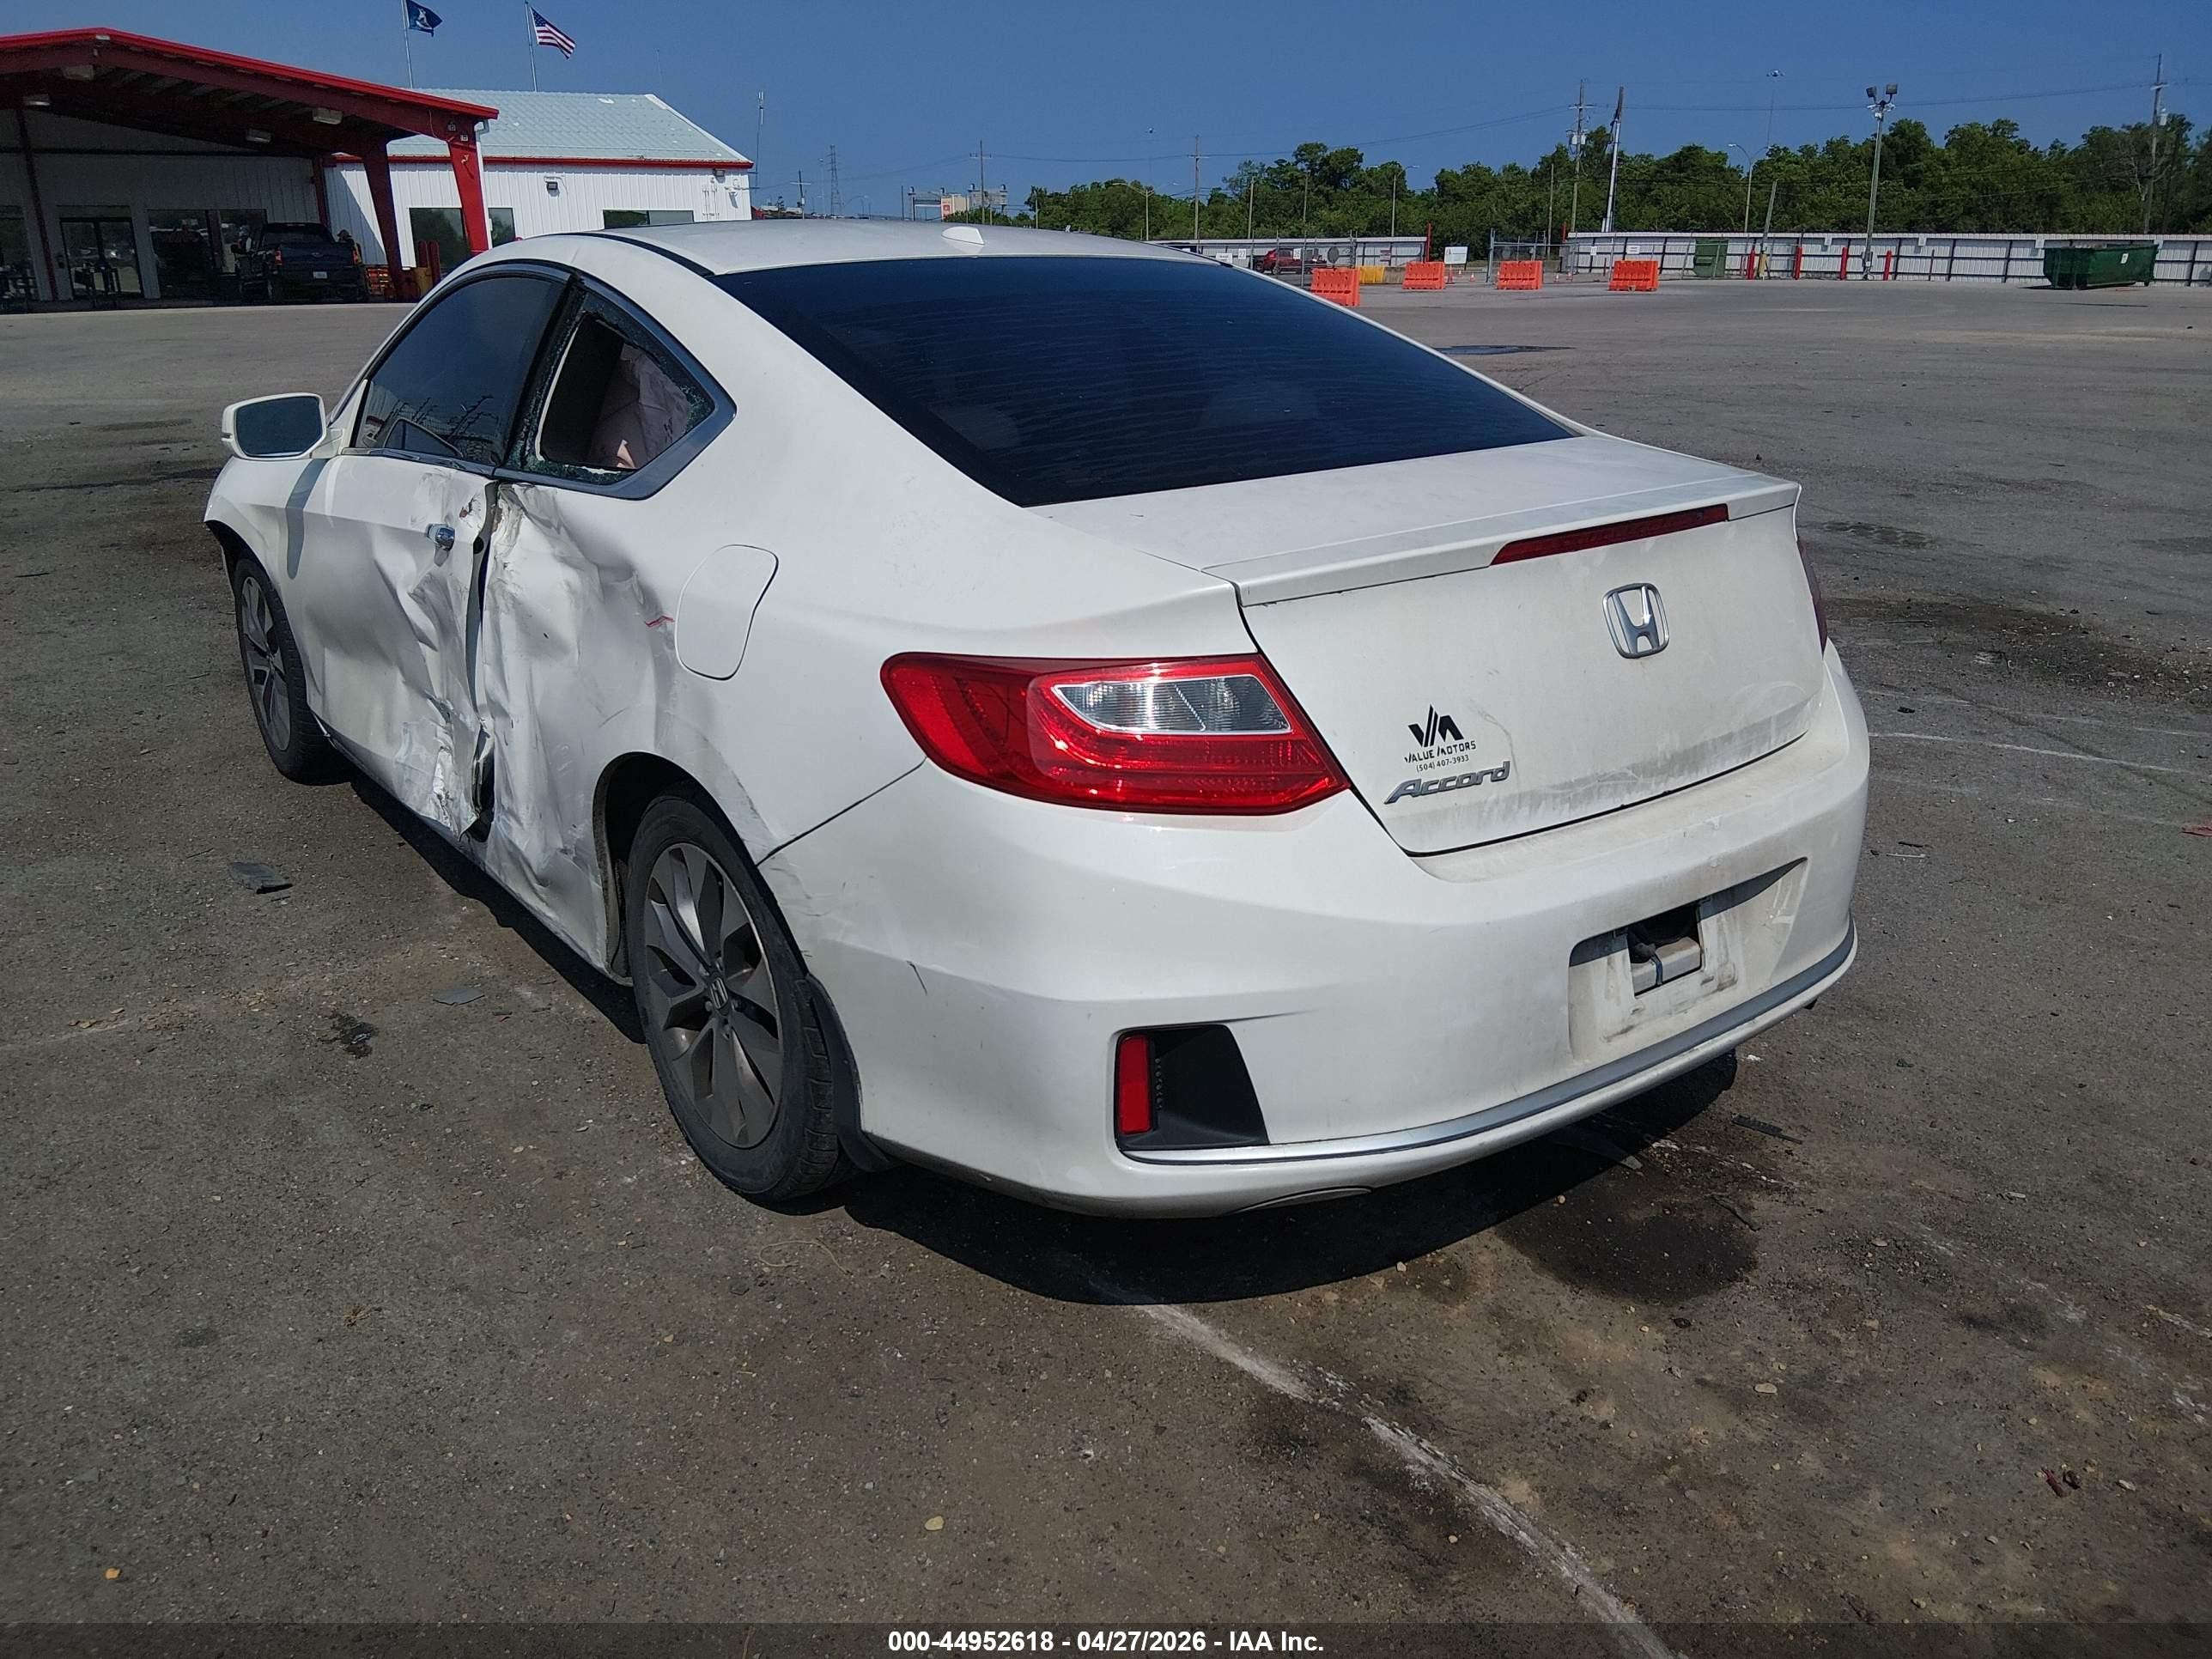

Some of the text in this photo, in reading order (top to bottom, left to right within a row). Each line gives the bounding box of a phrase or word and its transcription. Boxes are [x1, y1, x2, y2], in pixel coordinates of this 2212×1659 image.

[1404, 740, 1477, 763] VALUE MOTORS
[1416, 754, 1469, 773] (504) 407-3933
[1383, 761, 1510, 805] Accord
